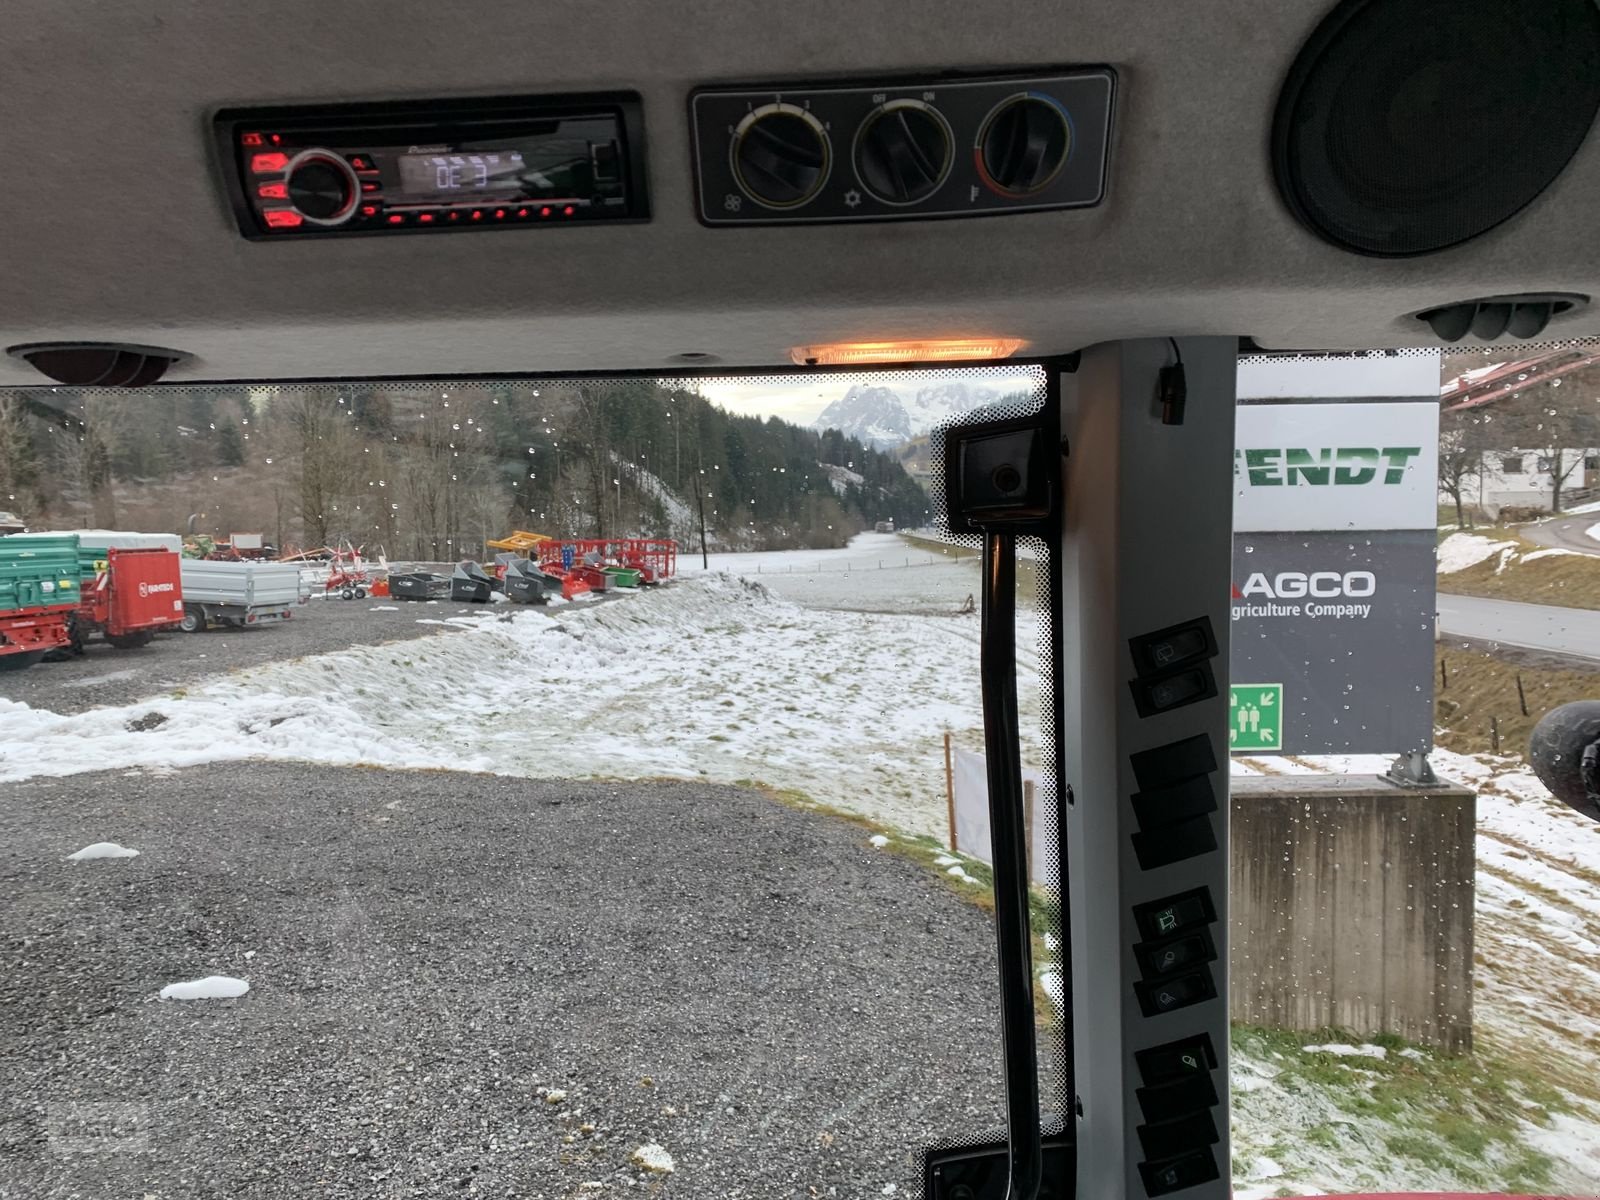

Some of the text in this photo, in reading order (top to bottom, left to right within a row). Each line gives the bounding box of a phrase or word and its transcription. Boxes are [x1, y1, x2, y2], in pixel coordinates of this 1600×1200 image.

[1241, 571, 1376, 598] AGCO
[1232, 602, 1371, 620] griculture Company
